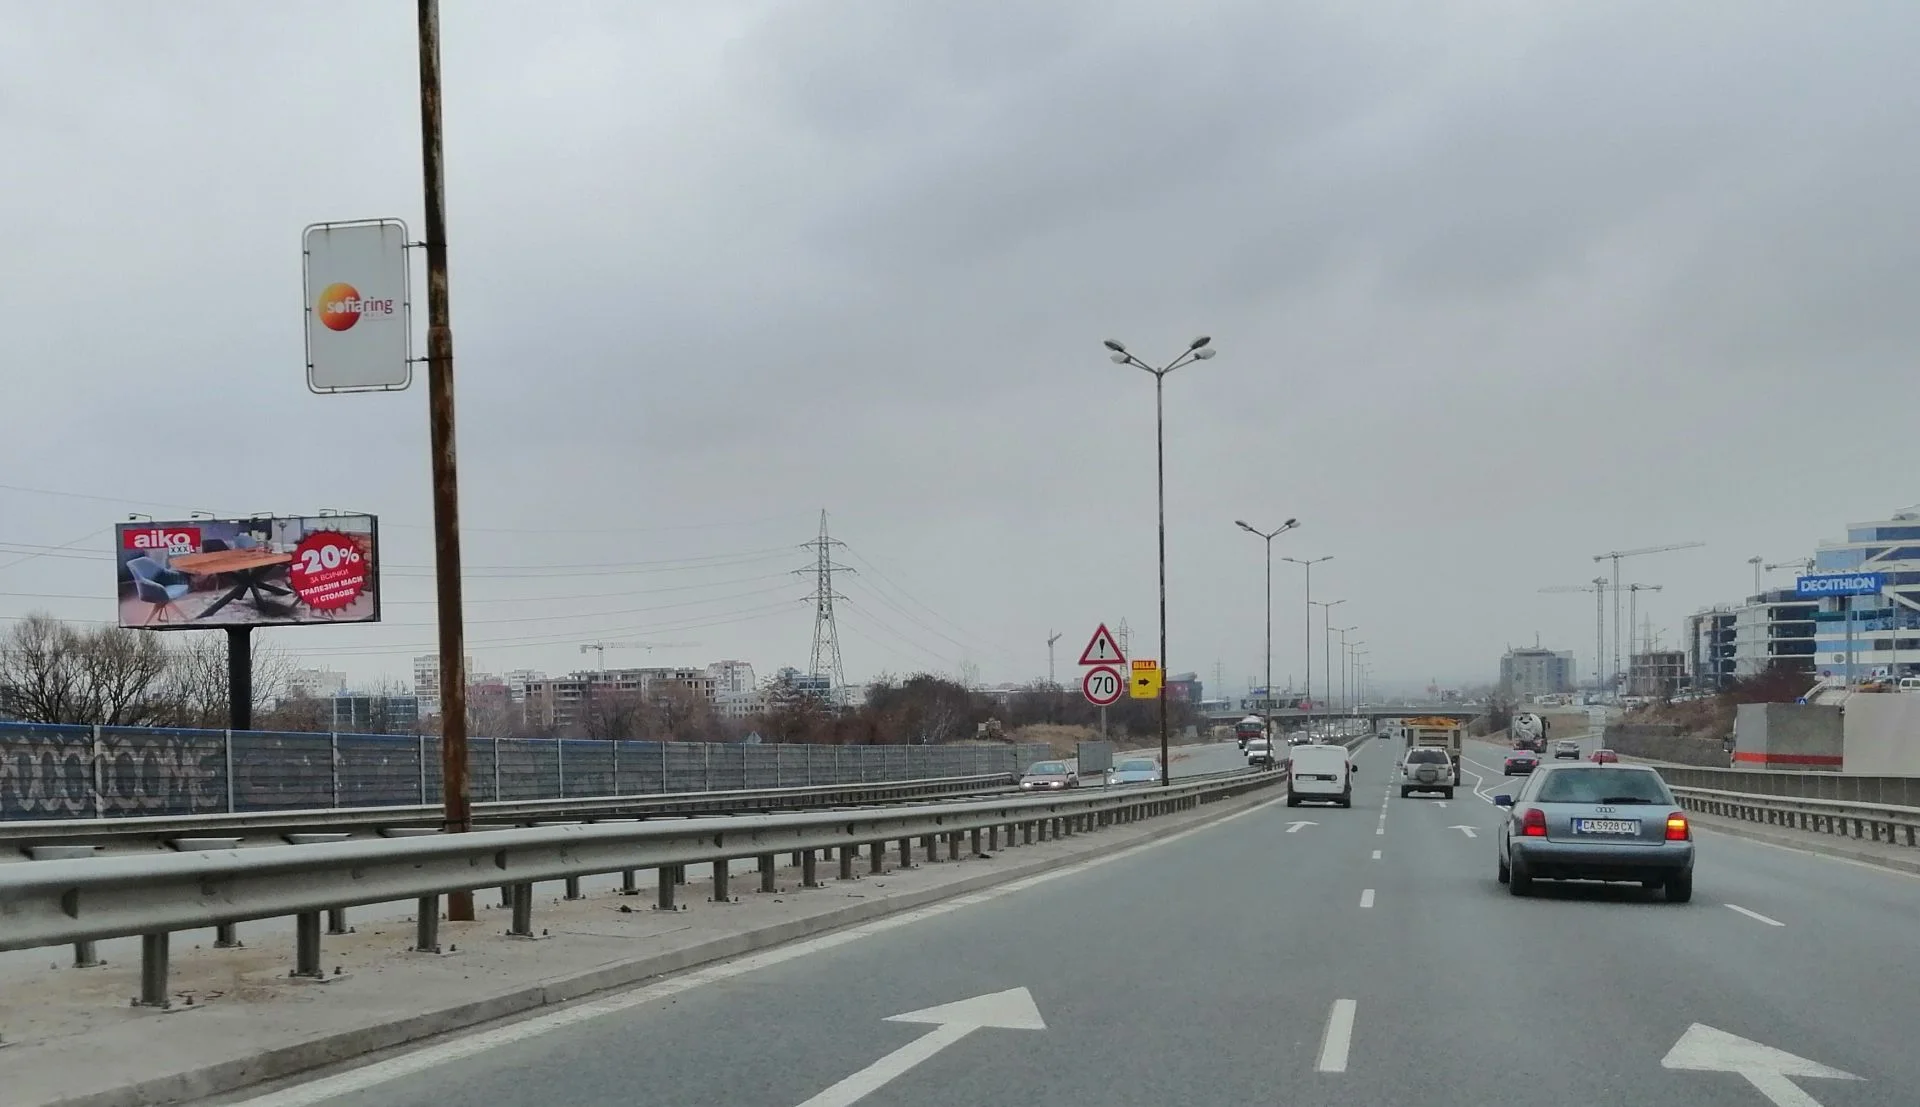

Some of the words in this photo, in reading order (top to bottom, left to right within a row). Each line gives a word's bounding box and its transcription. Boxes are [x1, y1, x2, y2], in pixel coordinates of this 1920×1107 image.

[134, 530, 191, 548] aiko
[292, 544, 360, 575] -20%
[320, 569, 349, 581] ВСИЧКИ
[341, 576, 363, 588] МАСИ
[1800, 576, 1875, 592] DECATHLON
[320, 588, 355, 602] СТОЛОВЕ
[1133, 661, 1156, 669] BILLA
[1093, 676, 1114, 695] 70
[1583, 820, 1595, 830] CA
[1596, 821, 1620, 831] 5928
[1620, 822, 1633, 832] CX
